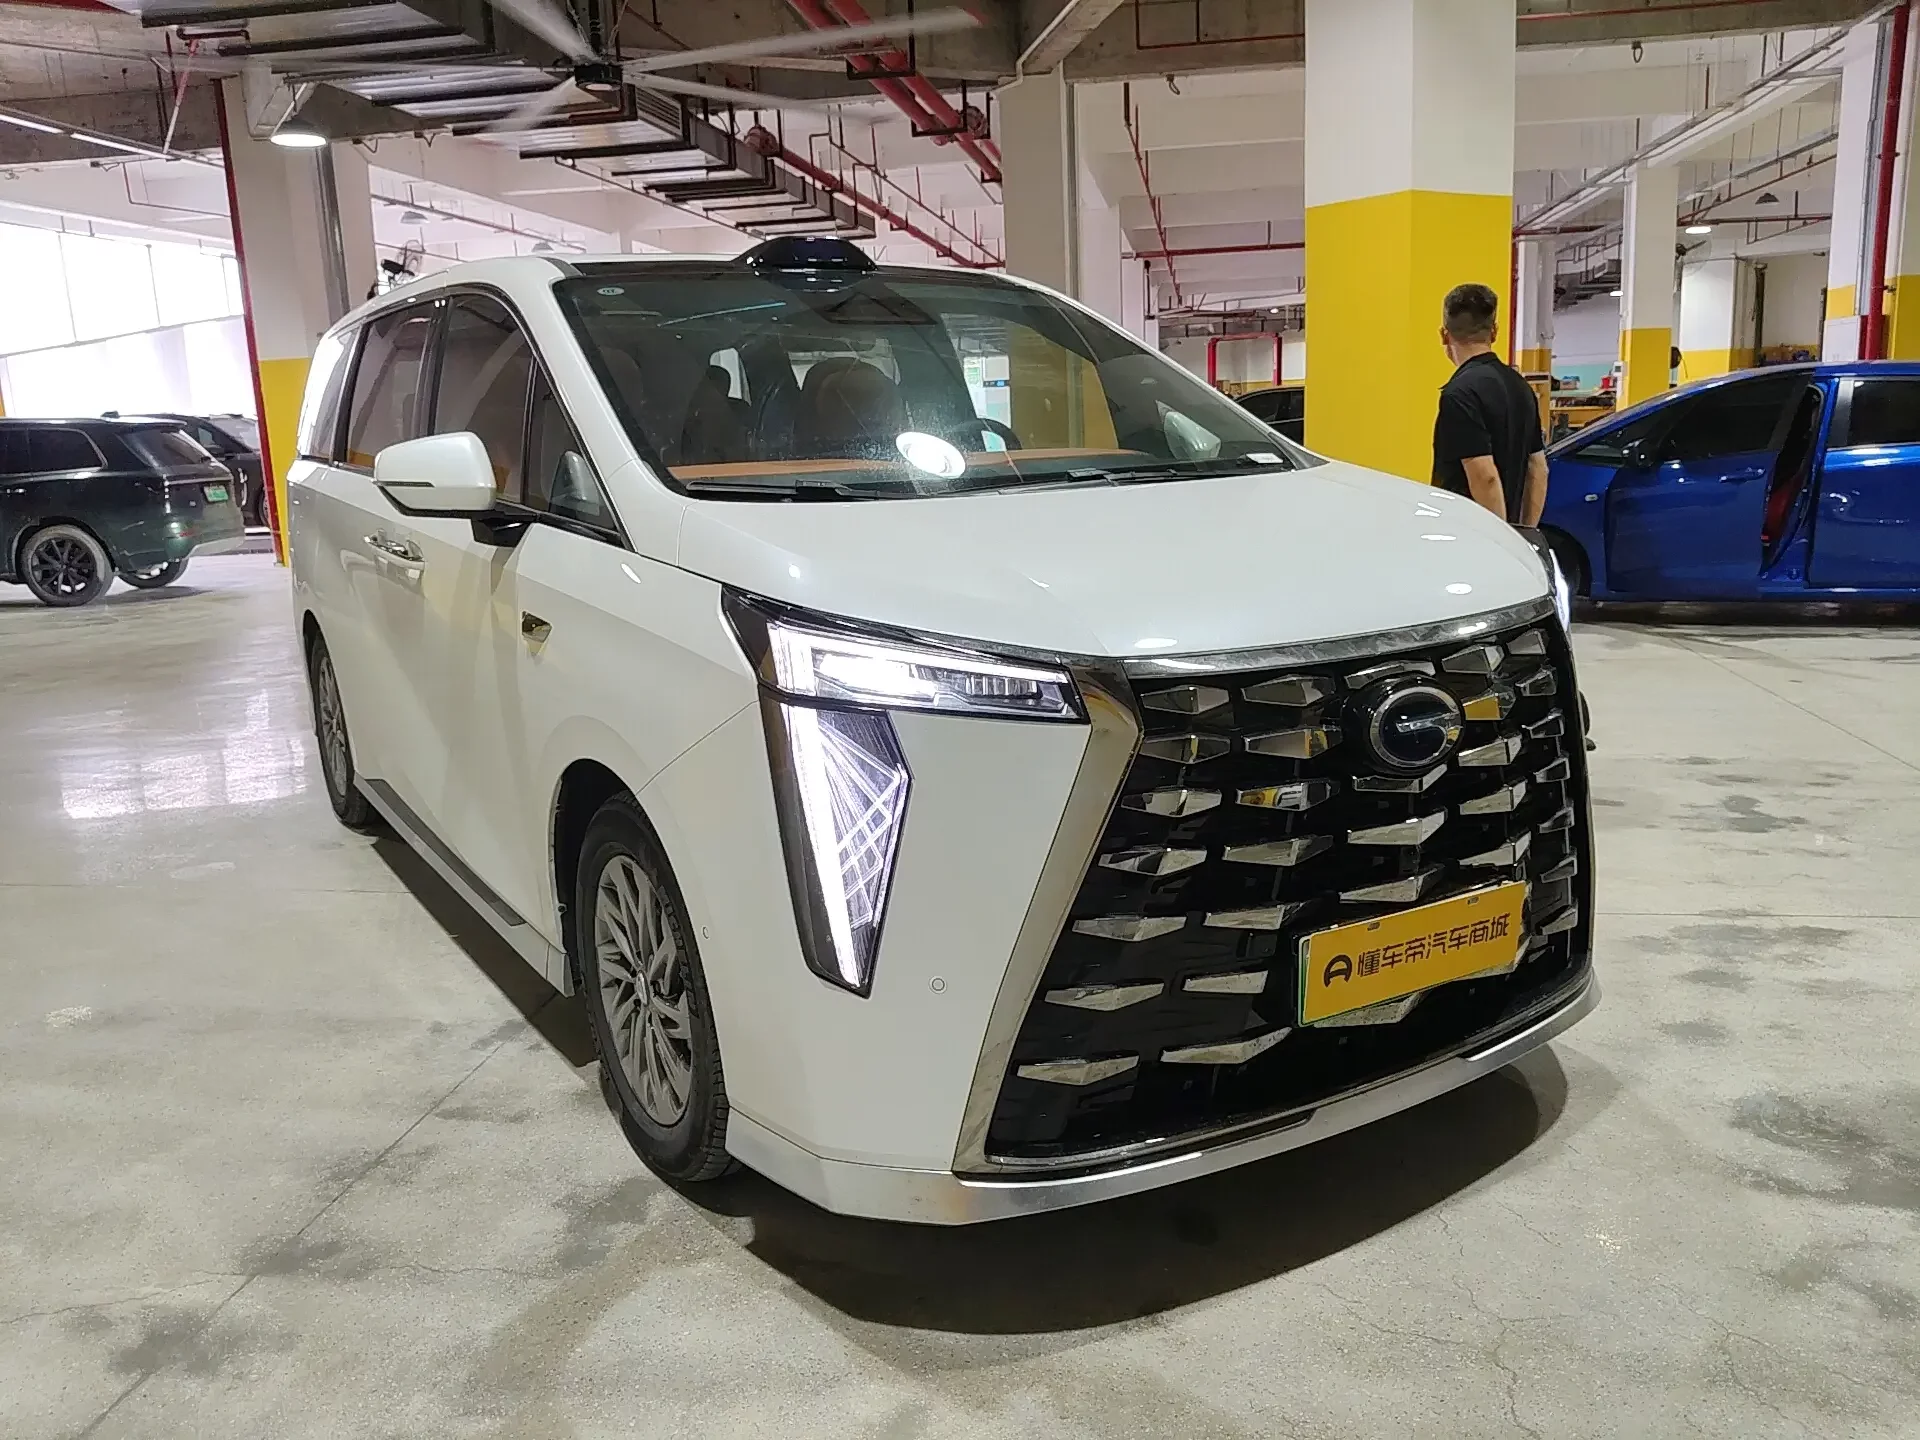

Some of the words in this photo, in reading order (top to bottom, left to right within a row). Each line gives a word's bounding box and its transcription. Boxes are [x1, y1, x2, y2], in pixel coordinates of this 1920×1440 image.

[1357, 913, 1511, 977] 懂车帝汽车商城
